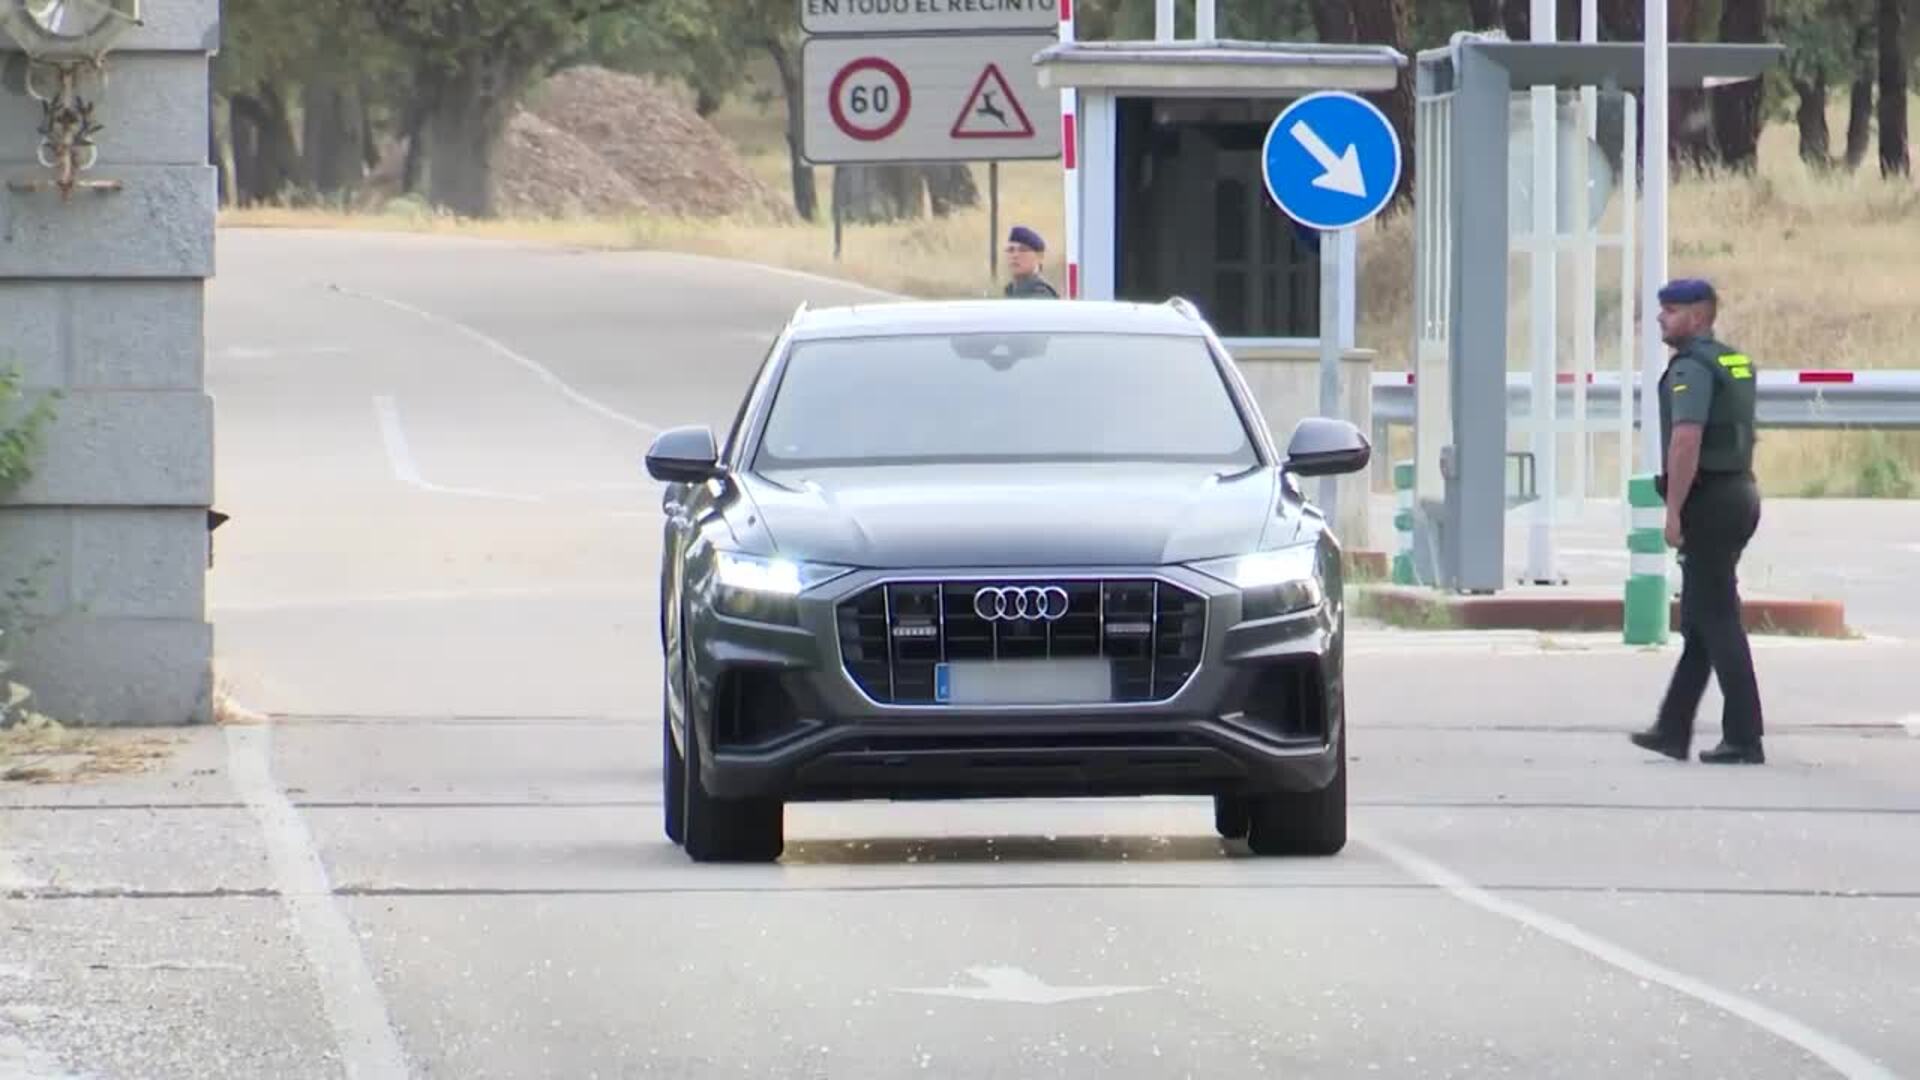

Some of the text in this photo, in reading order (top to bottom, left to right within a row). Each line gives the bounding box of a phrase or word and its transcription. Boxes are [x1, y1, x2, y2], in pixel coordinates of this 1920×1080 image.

[808, 0, 1056, 14] EN TODO EL RECINTO
[851, 85, 889, 113] 60
